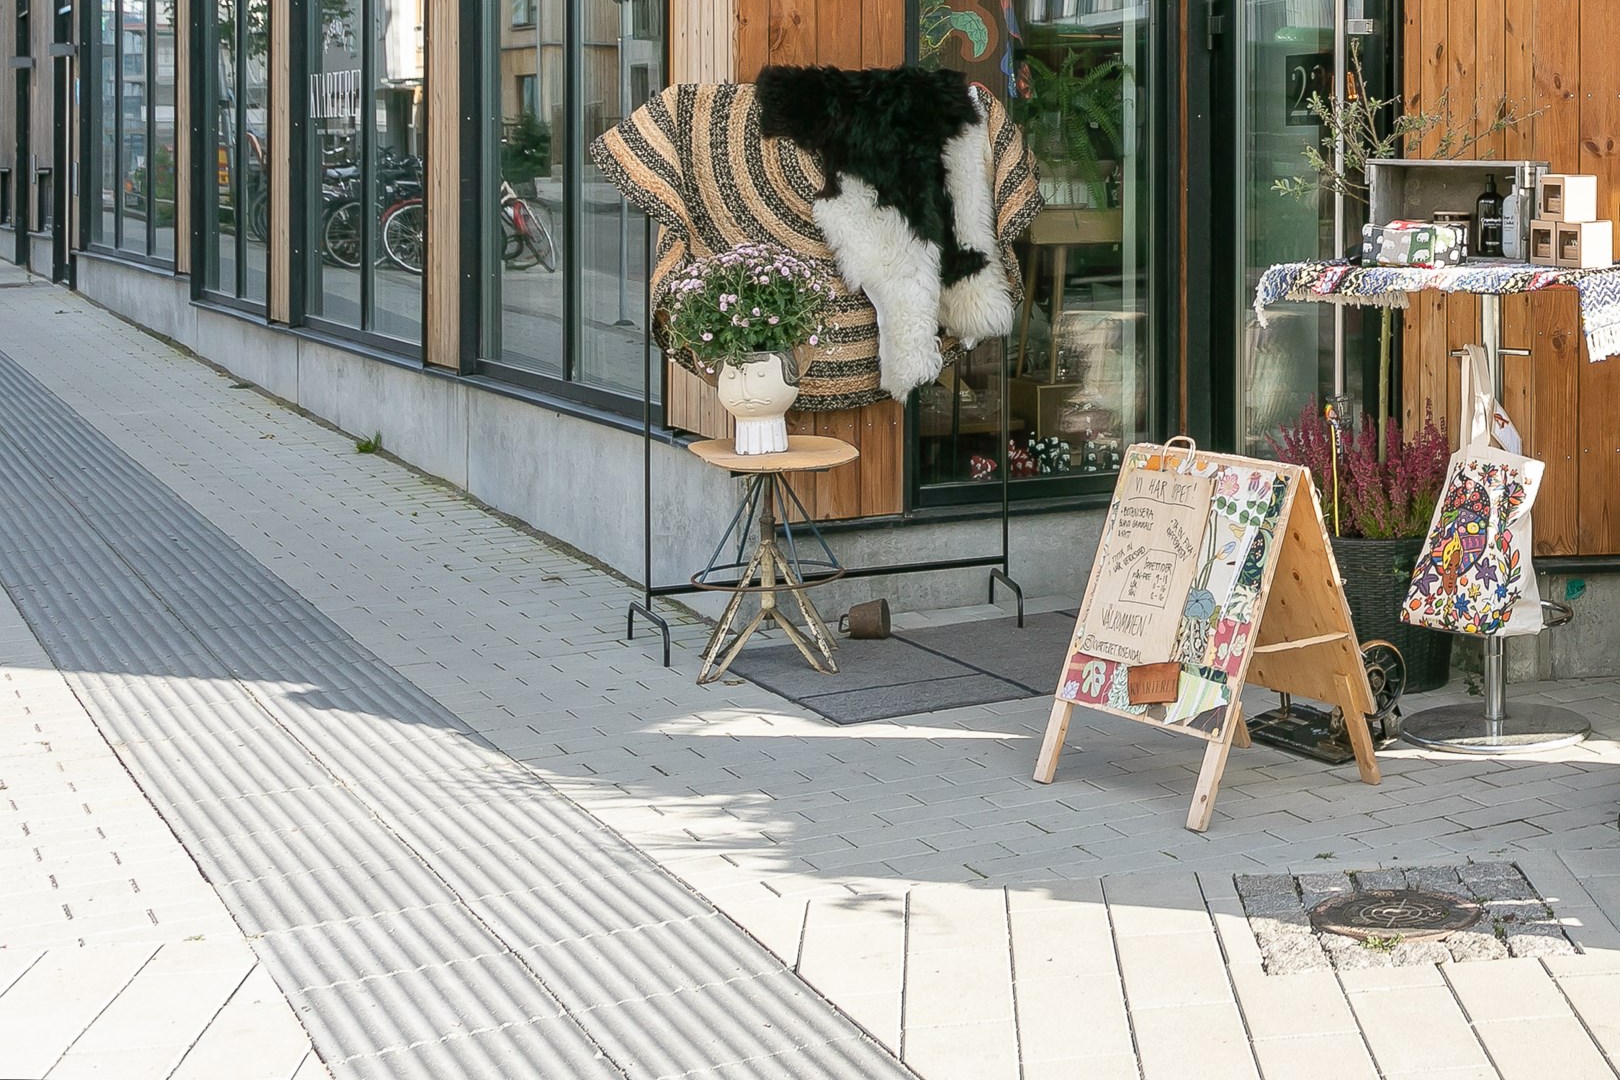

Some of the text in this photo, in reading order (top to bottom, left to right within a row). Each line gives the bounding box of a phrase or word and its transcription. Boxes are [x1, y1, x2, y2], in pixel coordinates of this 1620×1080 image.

[1135, 476, 1144, 494] VI
[1148, 478, 1168, 503] HAR
[1101, 603, 1153, 638] VÄLKOMMEN!
